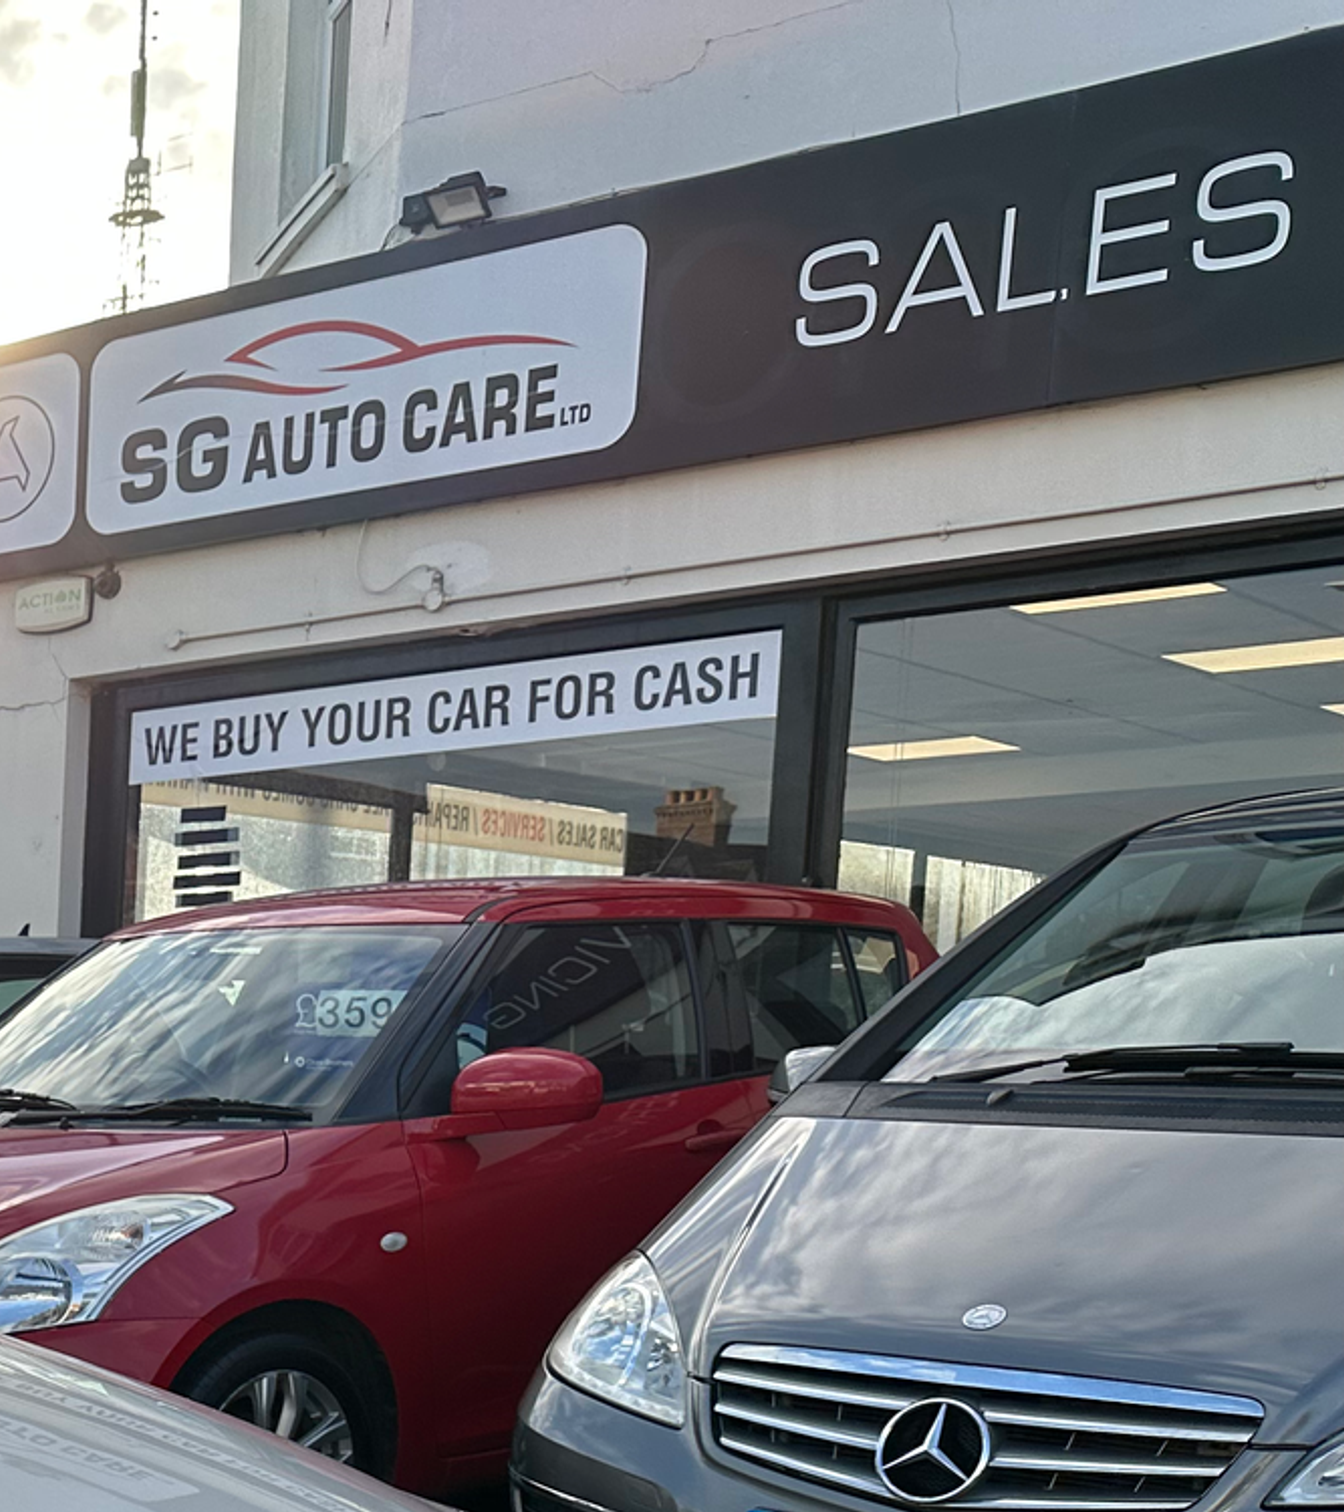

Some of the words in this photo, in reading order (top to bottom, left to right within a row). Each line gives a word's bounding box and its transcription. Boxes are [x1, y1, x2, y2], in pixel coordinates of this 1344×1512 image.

[795, 151, 1294, 347] SALES
[120, 415, 230, 505] SG
[242, 398, 385, 484] AUTO
[402, 364, 559, 453] CARE
[559, 402, 592, 427] LTD
[144, 721, 199, 767] WE
[212, 710, 289, 759] BUY
[302, 696, 410, 750] YOUR
[427, 682, 511, 735] CAR
[528, 671, 615, 724] FOR
[632, 652, 760, 711] CASH
